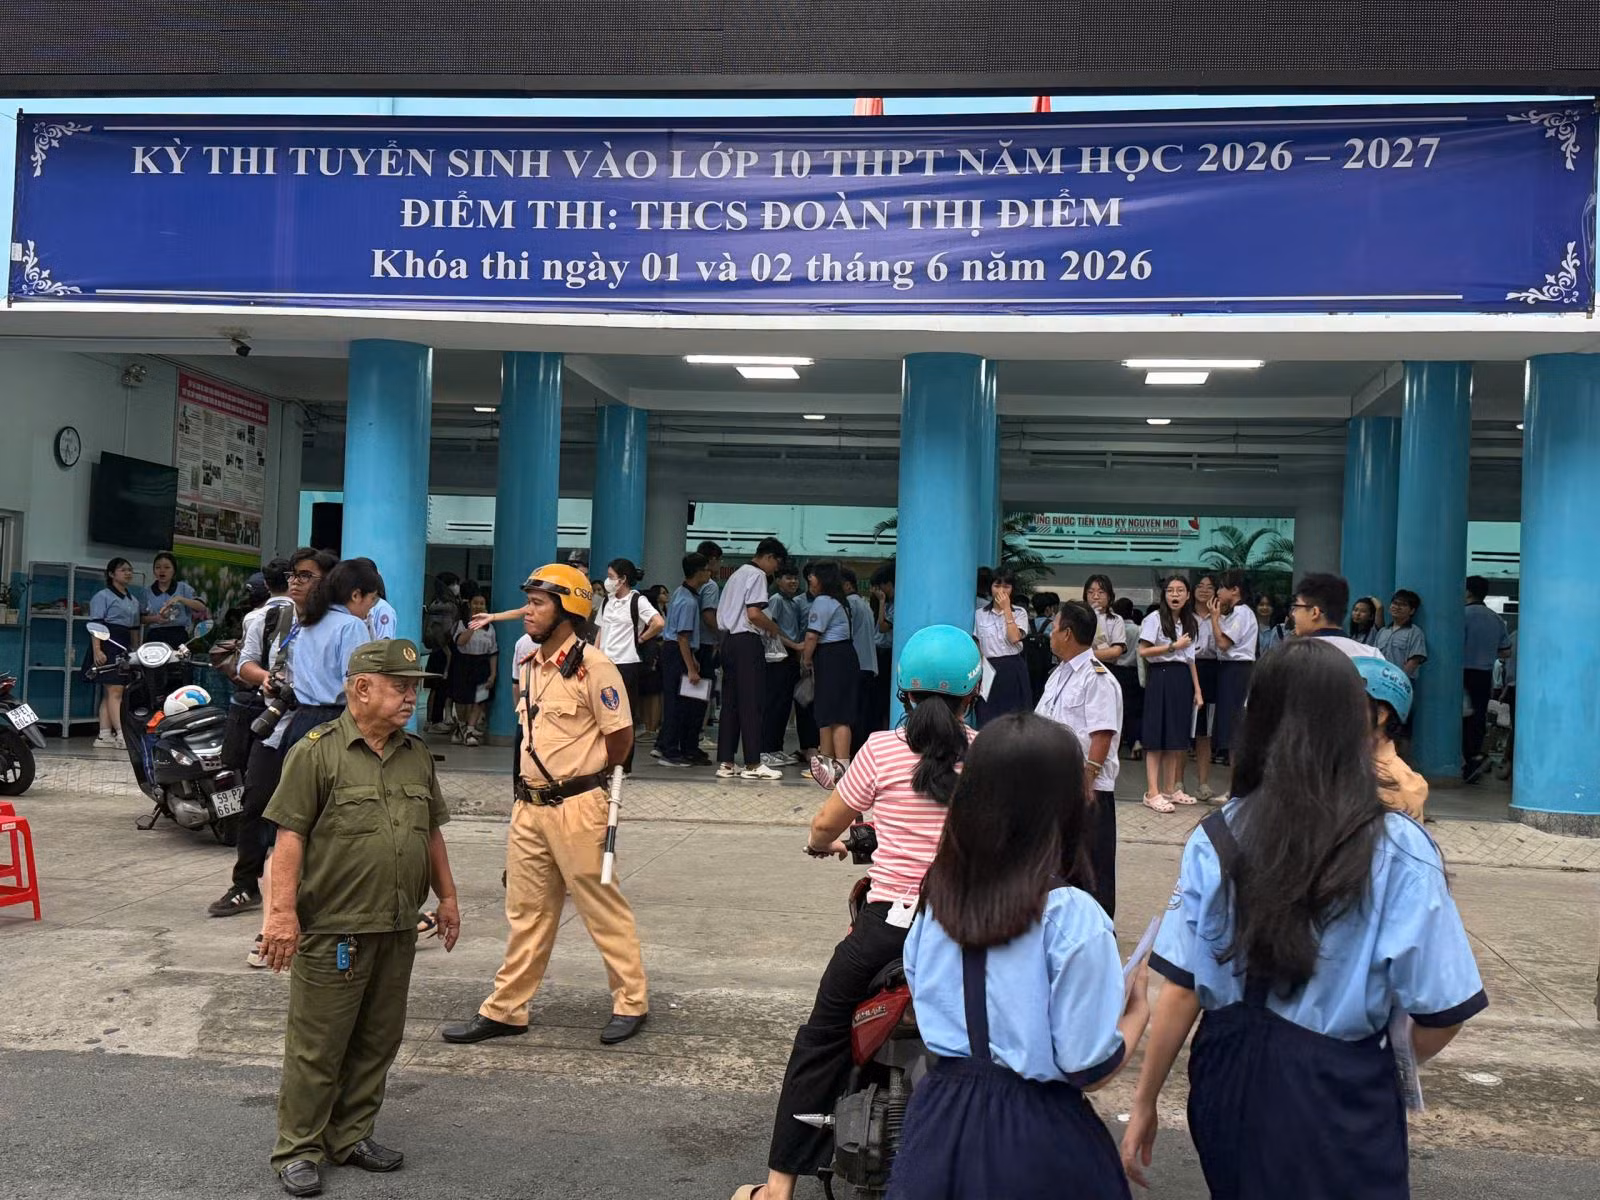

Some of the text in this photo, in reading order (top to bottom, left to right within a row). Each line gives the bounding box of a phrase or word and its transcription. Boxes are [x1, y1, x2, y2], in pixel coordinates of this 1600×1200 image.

[131, 138, 192, 174] KỲ
[203, 147, 277, 175] THI
[289, 139, 436, 177] TUYỂN
[448, 149, 551, 178] SINH
[563, 141, 657, 179] VÀO
[669, 141, 759, 178] LỚP
[771, 150, 811, 178] 10
[824, 149, 945, 177] THPT
[955, 139, 1065, 175] NĂM
[1078, 145, 1184, 182] HỌC
[1197, 142, 1293, 171] 2026
[1342, 137, 1440, 169] 2027
[400, 188, 1124, 237] ĐIỂM THI: THCS ĐOÀN THỊ ĐIỂM
[372, 250, 1153, 291] Khóa thi ngày 01 và 02 tháng 6 năm 2026
[574, 586, 593, 601] CSG
